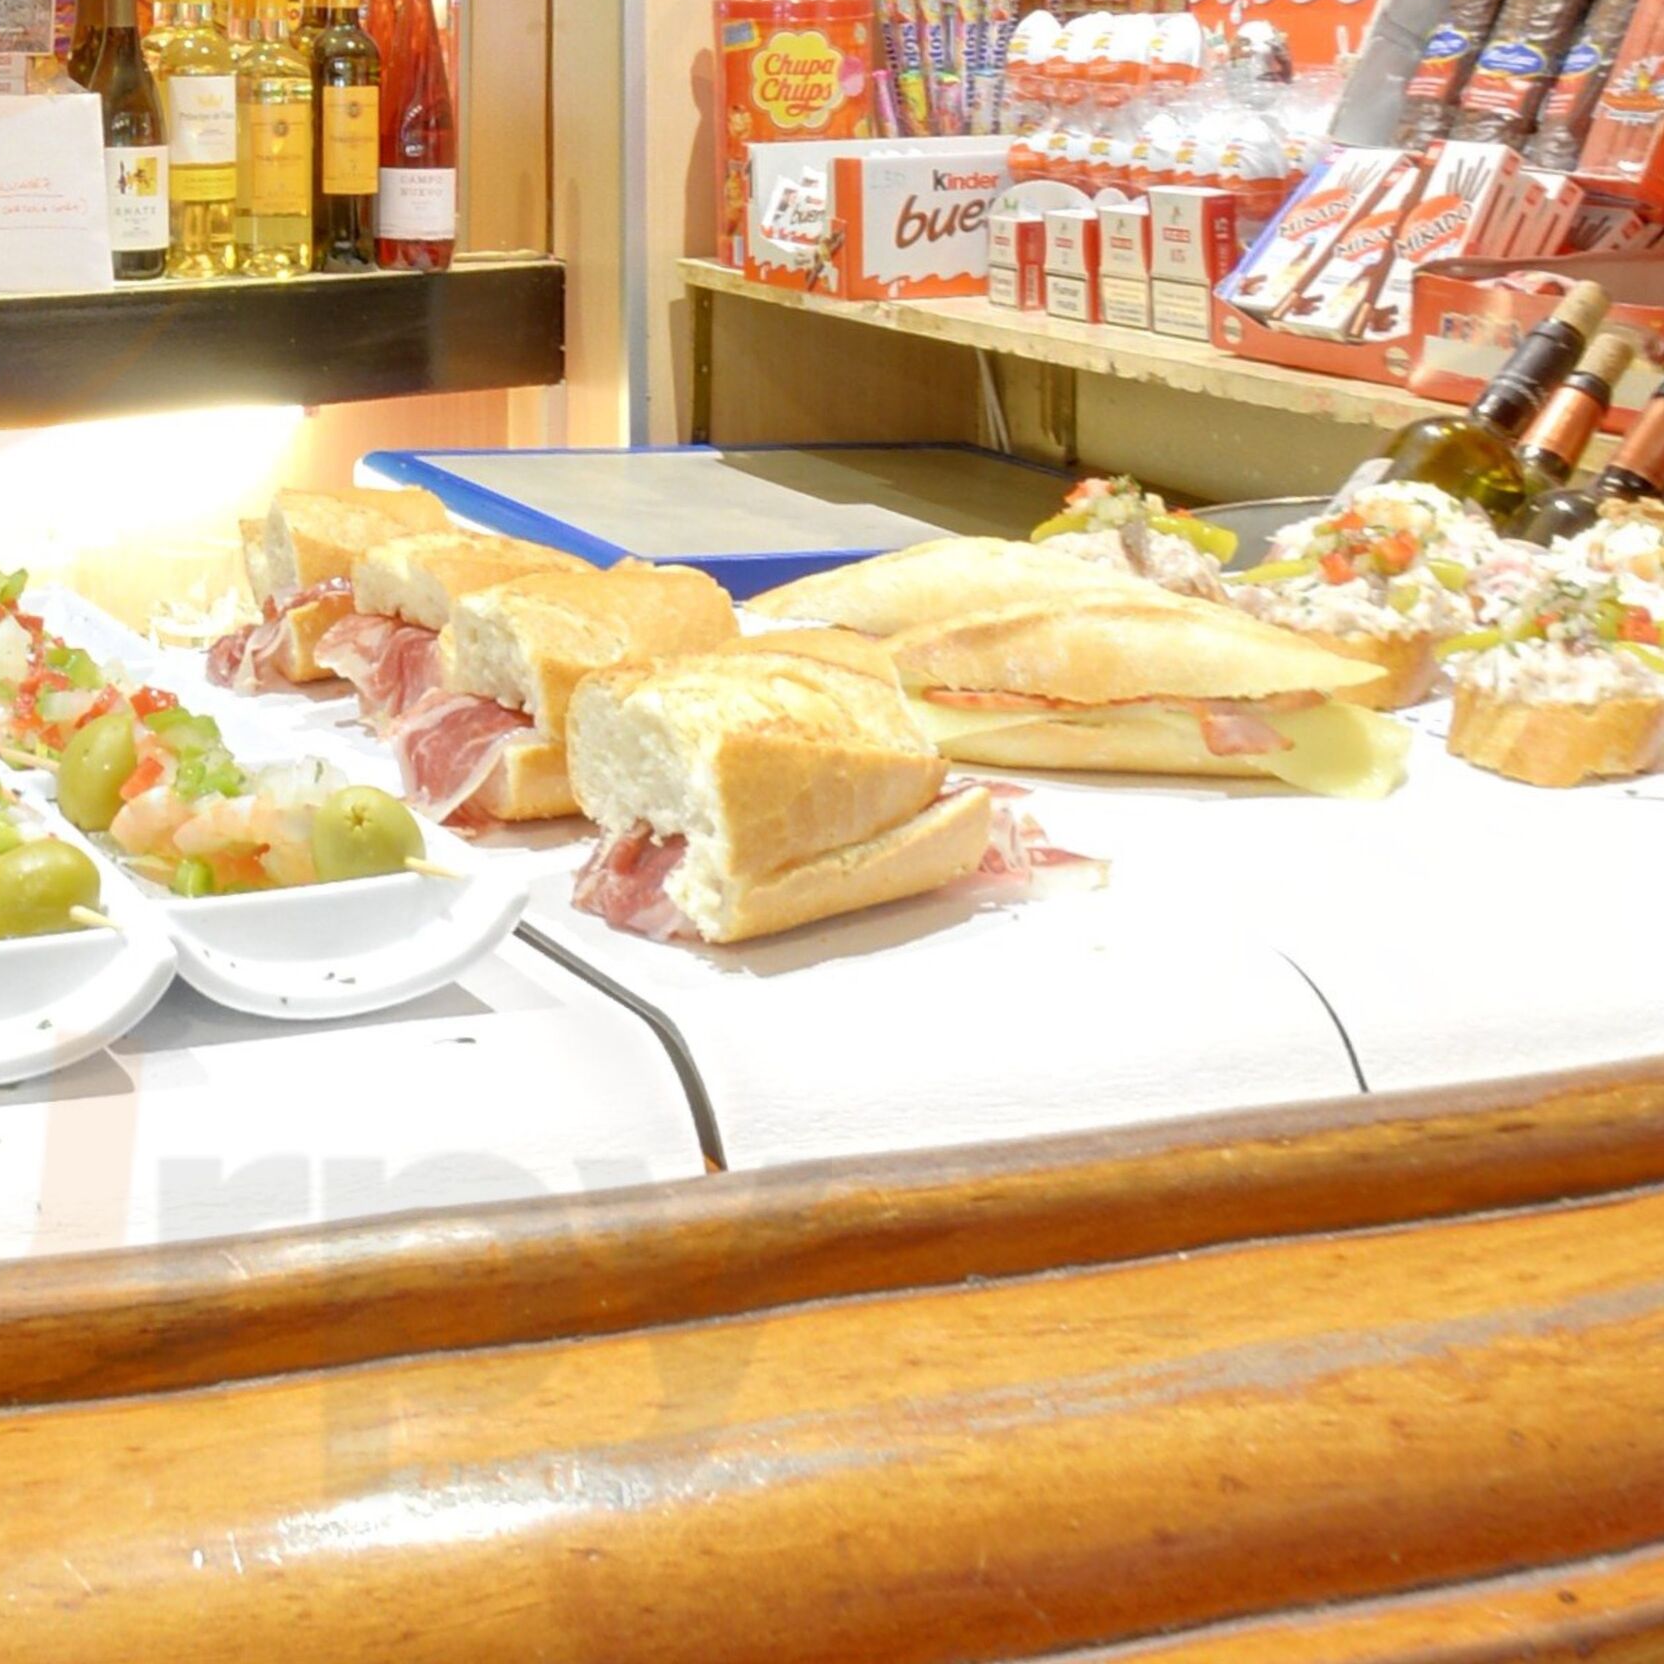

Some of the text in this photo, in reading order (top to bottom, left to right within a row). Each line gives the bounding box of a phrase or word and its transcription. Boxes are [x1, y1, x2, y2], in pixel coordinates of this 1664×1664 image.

[764, 52, 835, 80] Chupa
[761, 74, 835, 113] Chups
[1277, 192, 1360, 238] MIKADO
[1396, 201, 1473, 257] MIKADO
